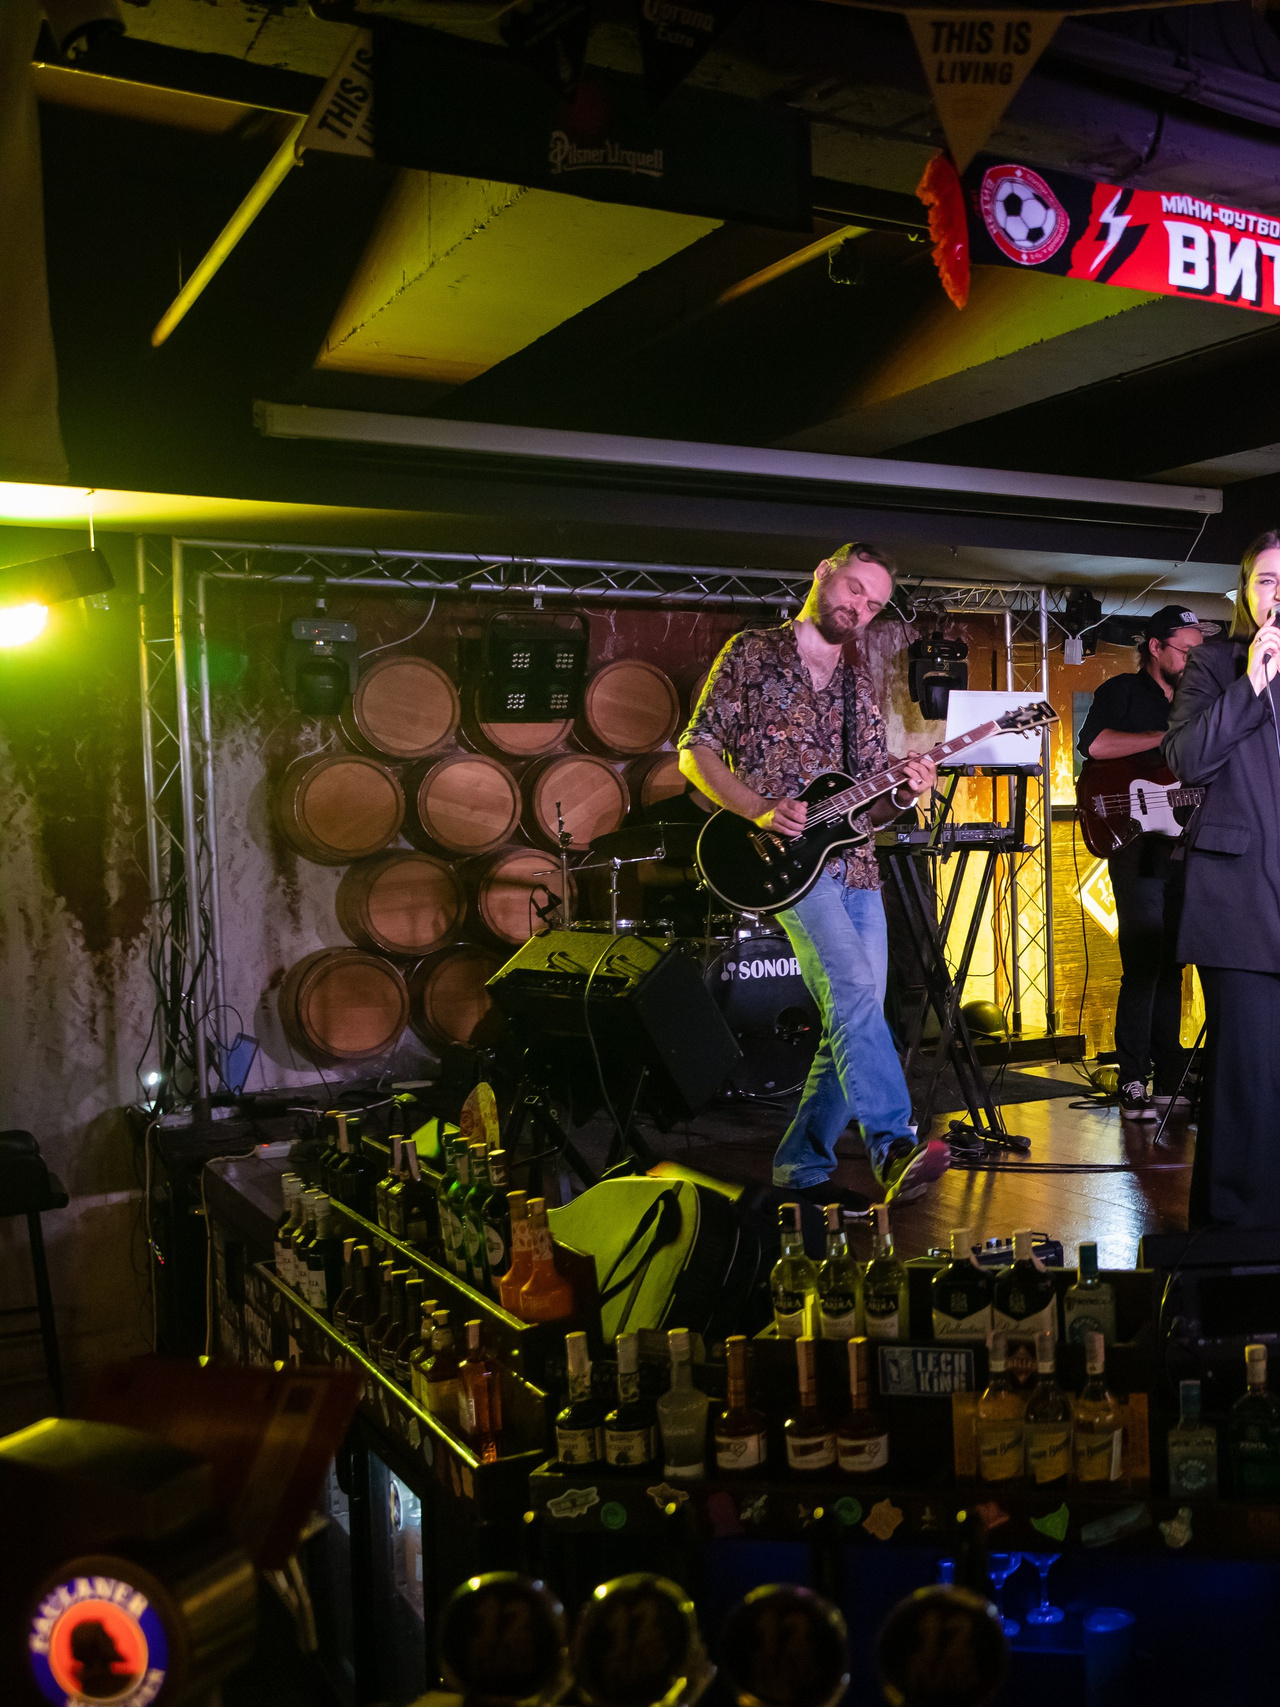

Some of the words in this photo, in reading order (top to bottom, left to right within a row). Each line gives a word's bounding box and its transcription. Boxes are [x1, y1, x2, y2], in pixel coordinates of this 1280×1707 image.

[931, 21, 994, 54] THIS
[1003, 21, 1032, 55] IS
[936, 61, 1014, 85] LIVING
[318, 78, 371, 140] THIS
[549, 130, 603, 175] Pilsner
[604, 138, 664, 175] Urquell
[738, 957, 802, 980] SONOR
